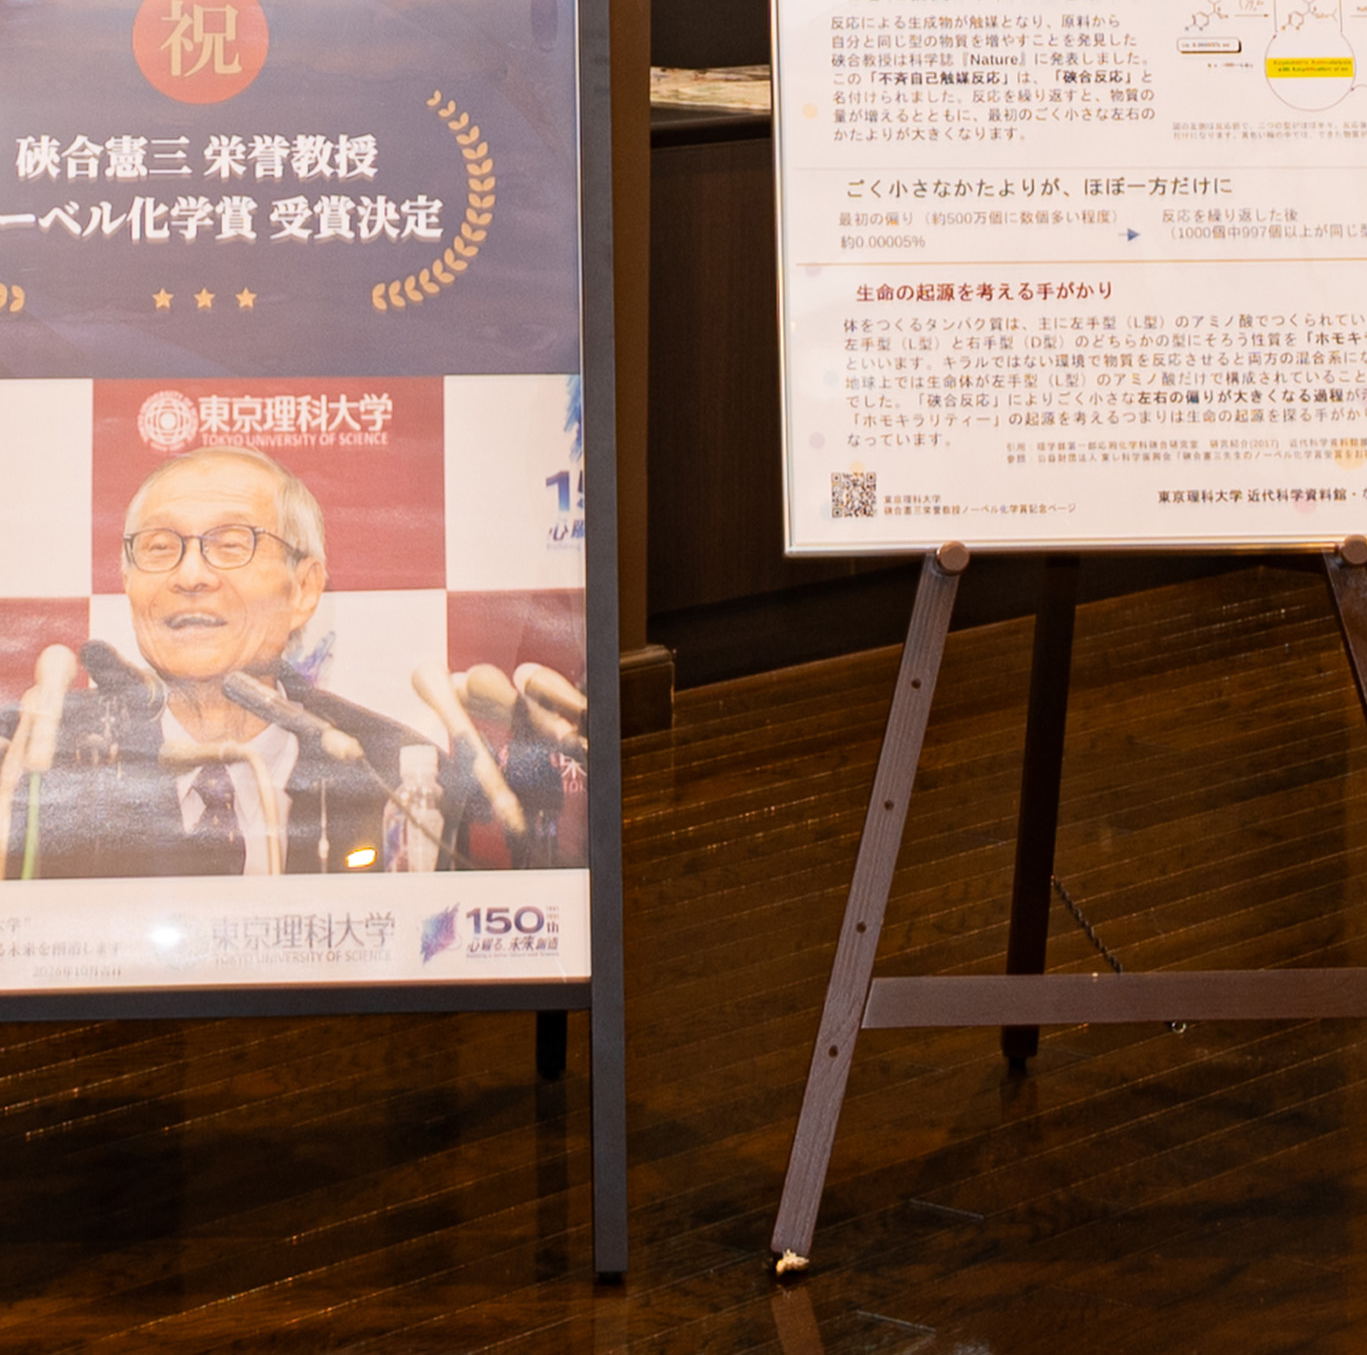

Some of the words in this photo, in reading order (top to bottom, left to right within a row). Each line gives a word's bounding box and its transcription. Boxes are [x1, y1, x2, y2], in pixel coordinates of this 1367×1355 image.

[160, 0, 243, 78] 祝
[15, 133, 192, 180] 硤合憲三
[203, 132, 379, 180] 栄誉教授
[847, 177, 1232, 198] ごく小さなかたよりが、ほぼ一方だけに
[270, 194, 444, 241] 受賞決定
[856, 281, 1112, 302] 生命の起源を考える手がかり
[198, 393, 392, 433] 東京理科大学
[202, 433, 244, 446] TOKYO
[246, 432, 317, 446] UNIVERSITY
[319, 432, 336, 445] OF
[339, 432, 388, 445] SCIENCE
[1158, 489, 1243, 504] 東京理科大学
[212, 911, 395, 949] 東京理科大学
